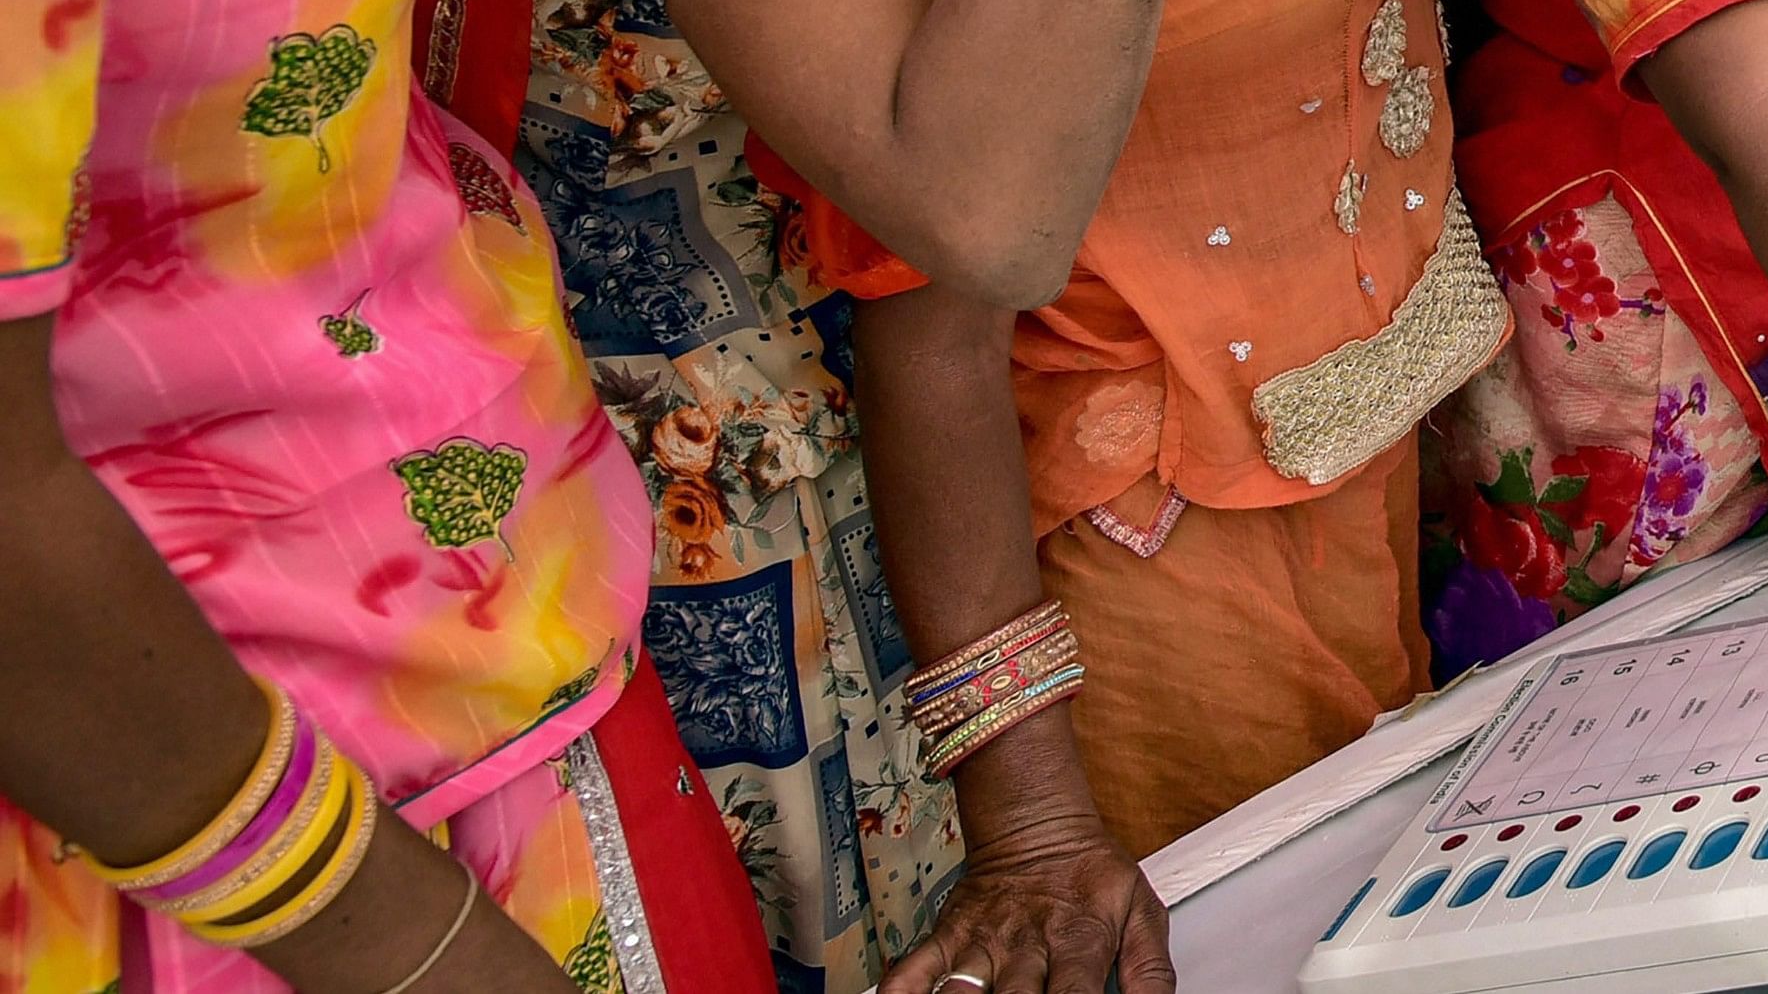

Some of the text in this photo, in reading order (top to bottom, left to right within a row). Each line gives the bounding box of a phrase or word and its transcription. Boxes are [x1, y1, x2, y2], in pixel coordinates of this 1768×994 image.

[1722, 640, 1745, 656] 13
[1667, 649, 1691, 666] 14
[1614, 659, 1637, 676] 15
[1560, 669, 1584, 686] 16
[1500, 679, 1534, 714] Election
[1461, 714, 1506, 769] Commission
[1430, 779, 1453, 804] India
